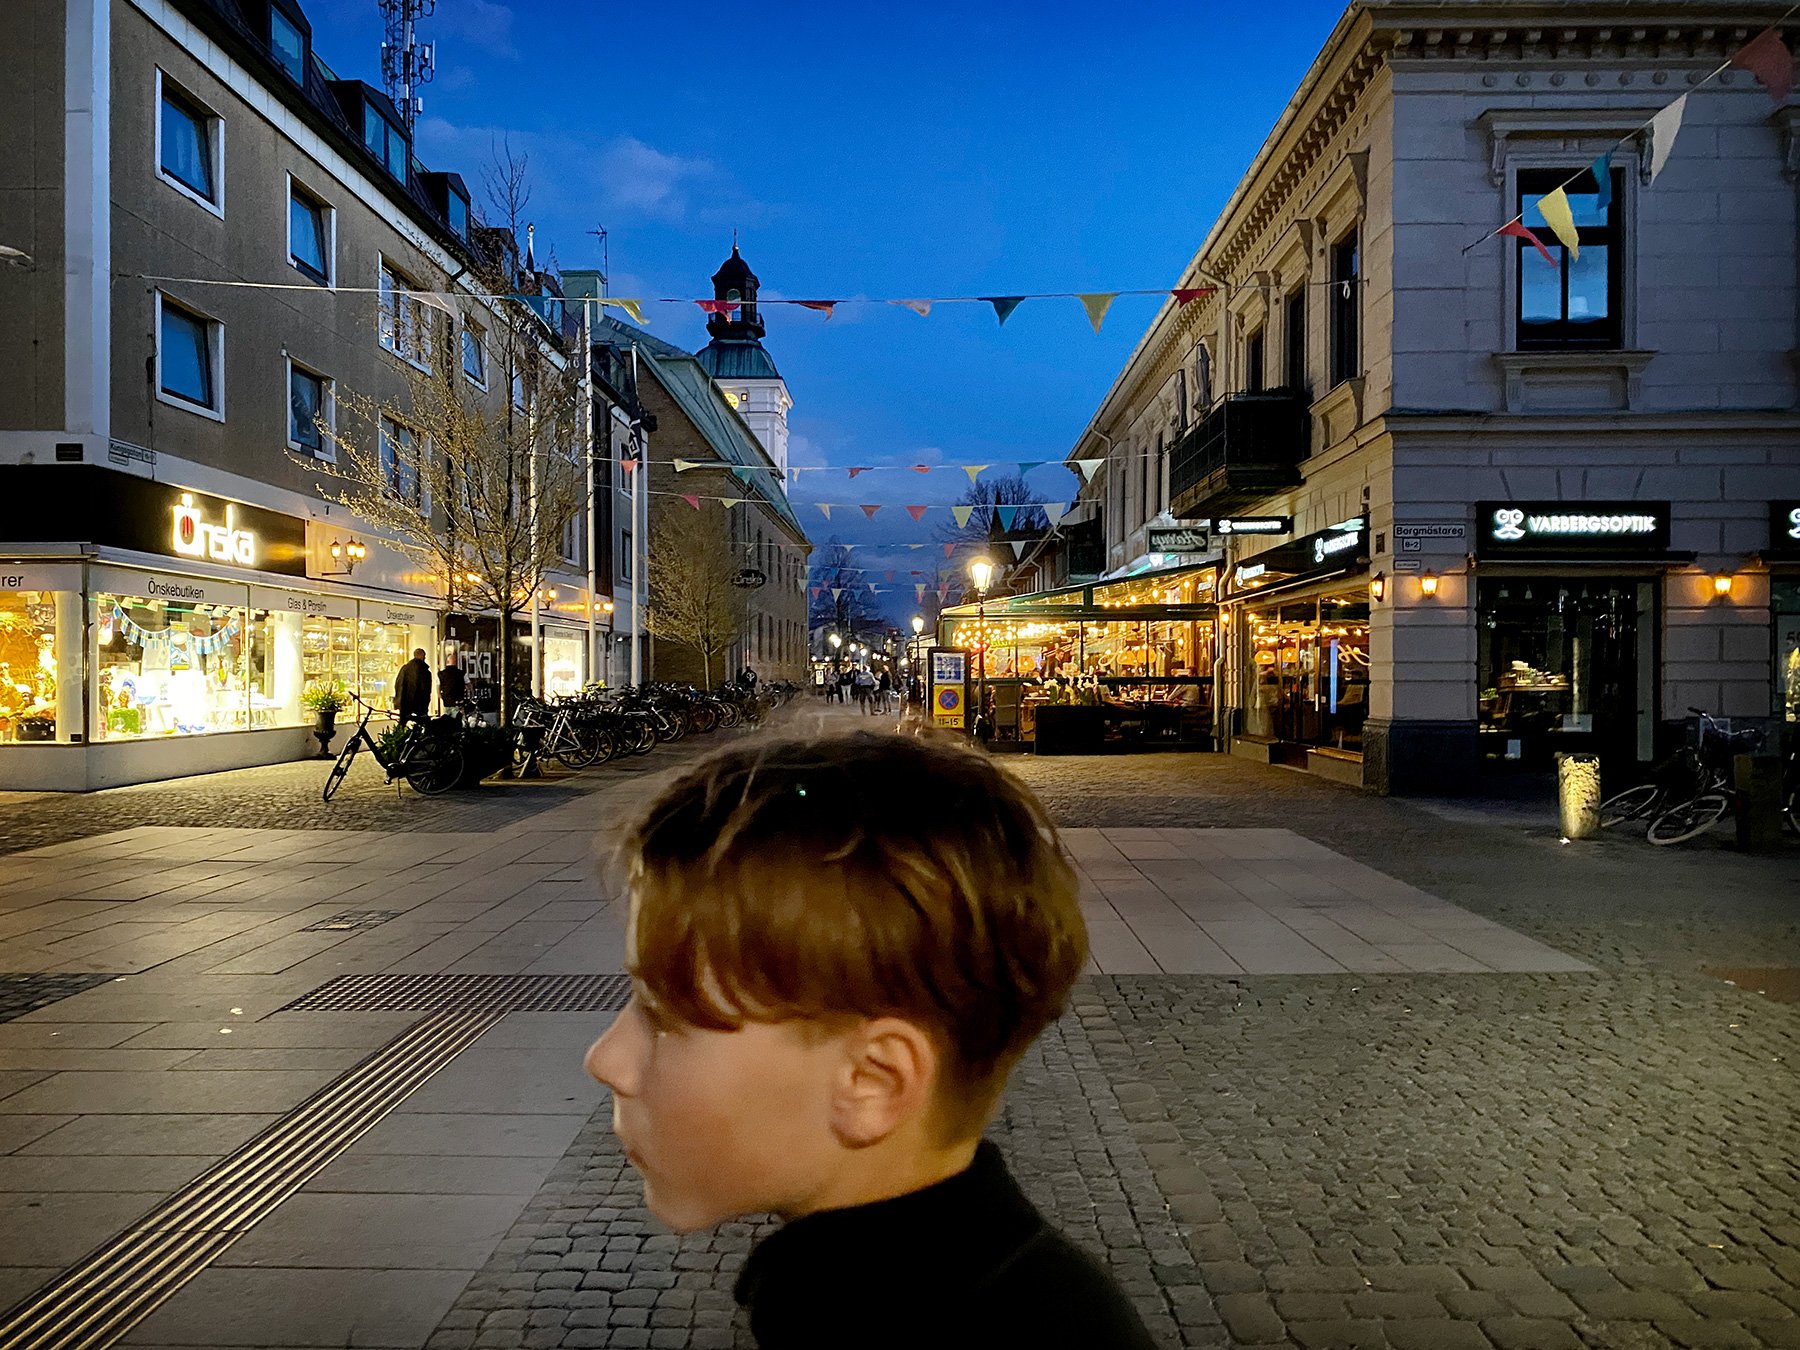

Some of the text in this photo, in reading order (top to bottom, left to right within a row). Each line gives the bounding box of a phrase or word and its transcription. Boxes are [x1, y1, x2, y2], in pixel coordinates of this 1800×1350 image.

[173, 493, 255, 565] Önska
[1396, 525, 1464, 537] Borgmästareg
[1528, 514, 1657, 533] VARBERGSOPTIK
[147, 577, 205, 599] Önskebutiken
[287, 597, 327, 612] Glas & Porslin
[938, 717, 959, 726] 11-15
